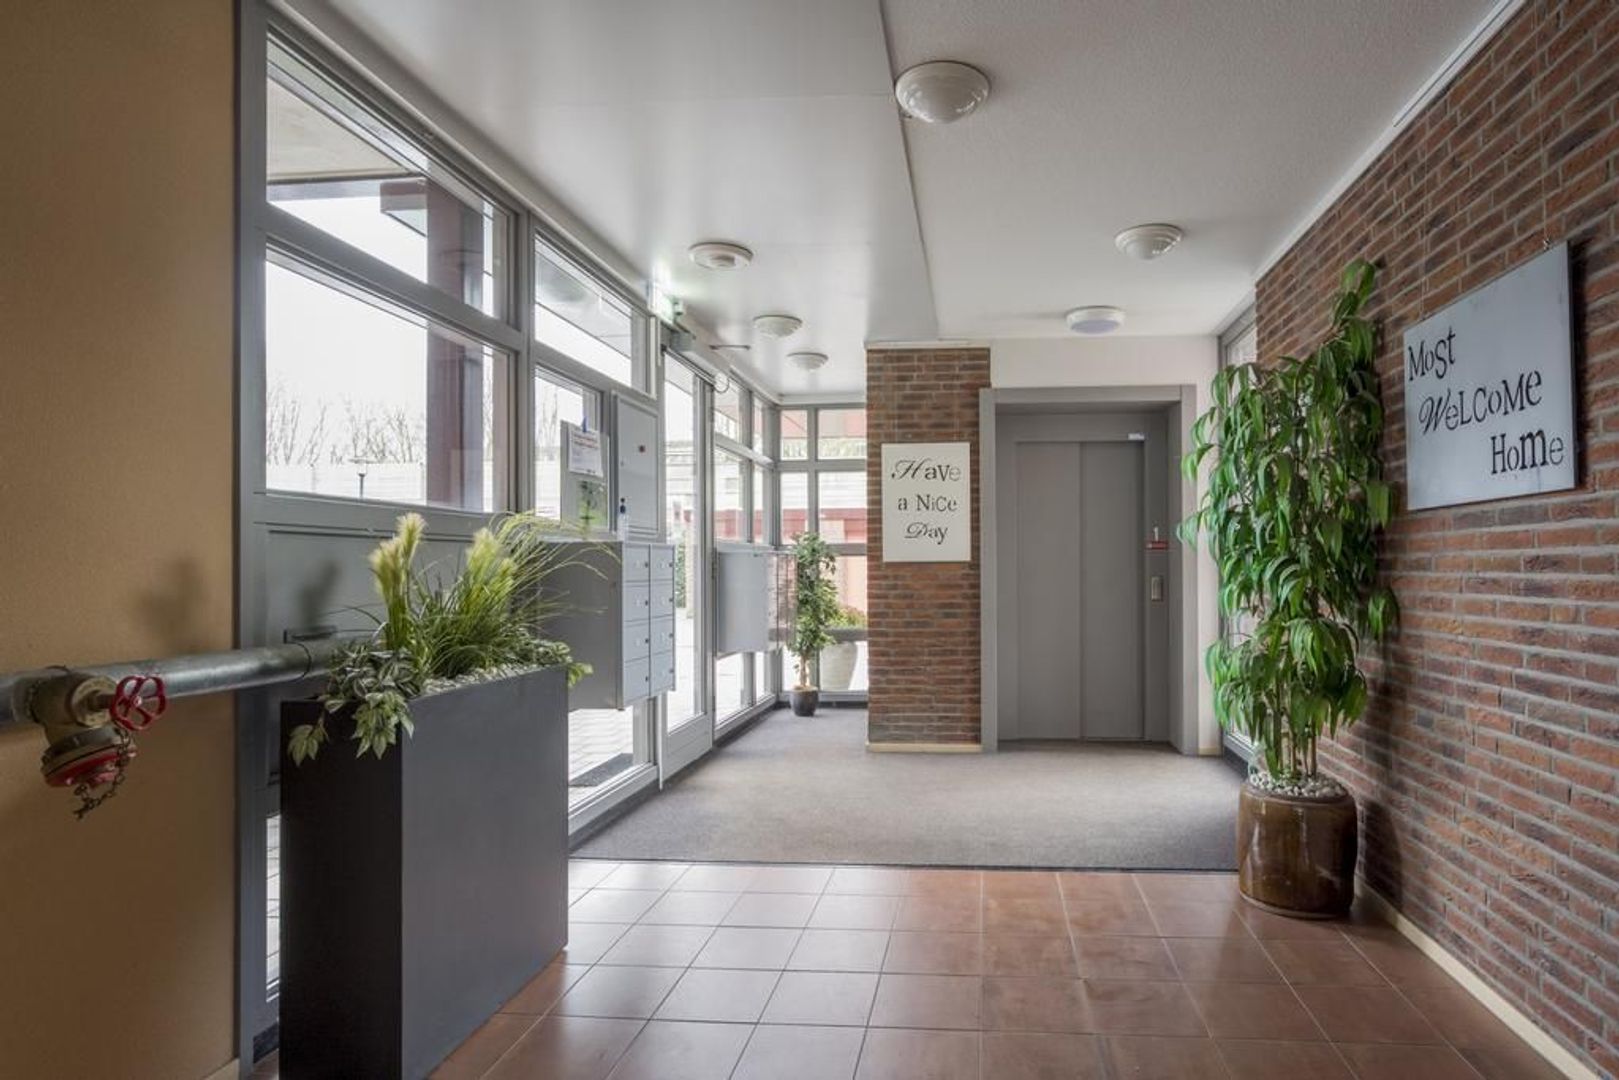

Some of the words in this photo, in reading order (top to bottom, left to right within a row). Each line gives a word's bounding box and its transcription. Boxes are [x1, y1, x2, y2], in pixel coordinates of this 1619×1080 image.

[1490, 428, 1564, 475] Home
[891, 458, 961, 482] Have
[898, 497, 908, 511] a
[904, 521, 948, 545] Day
